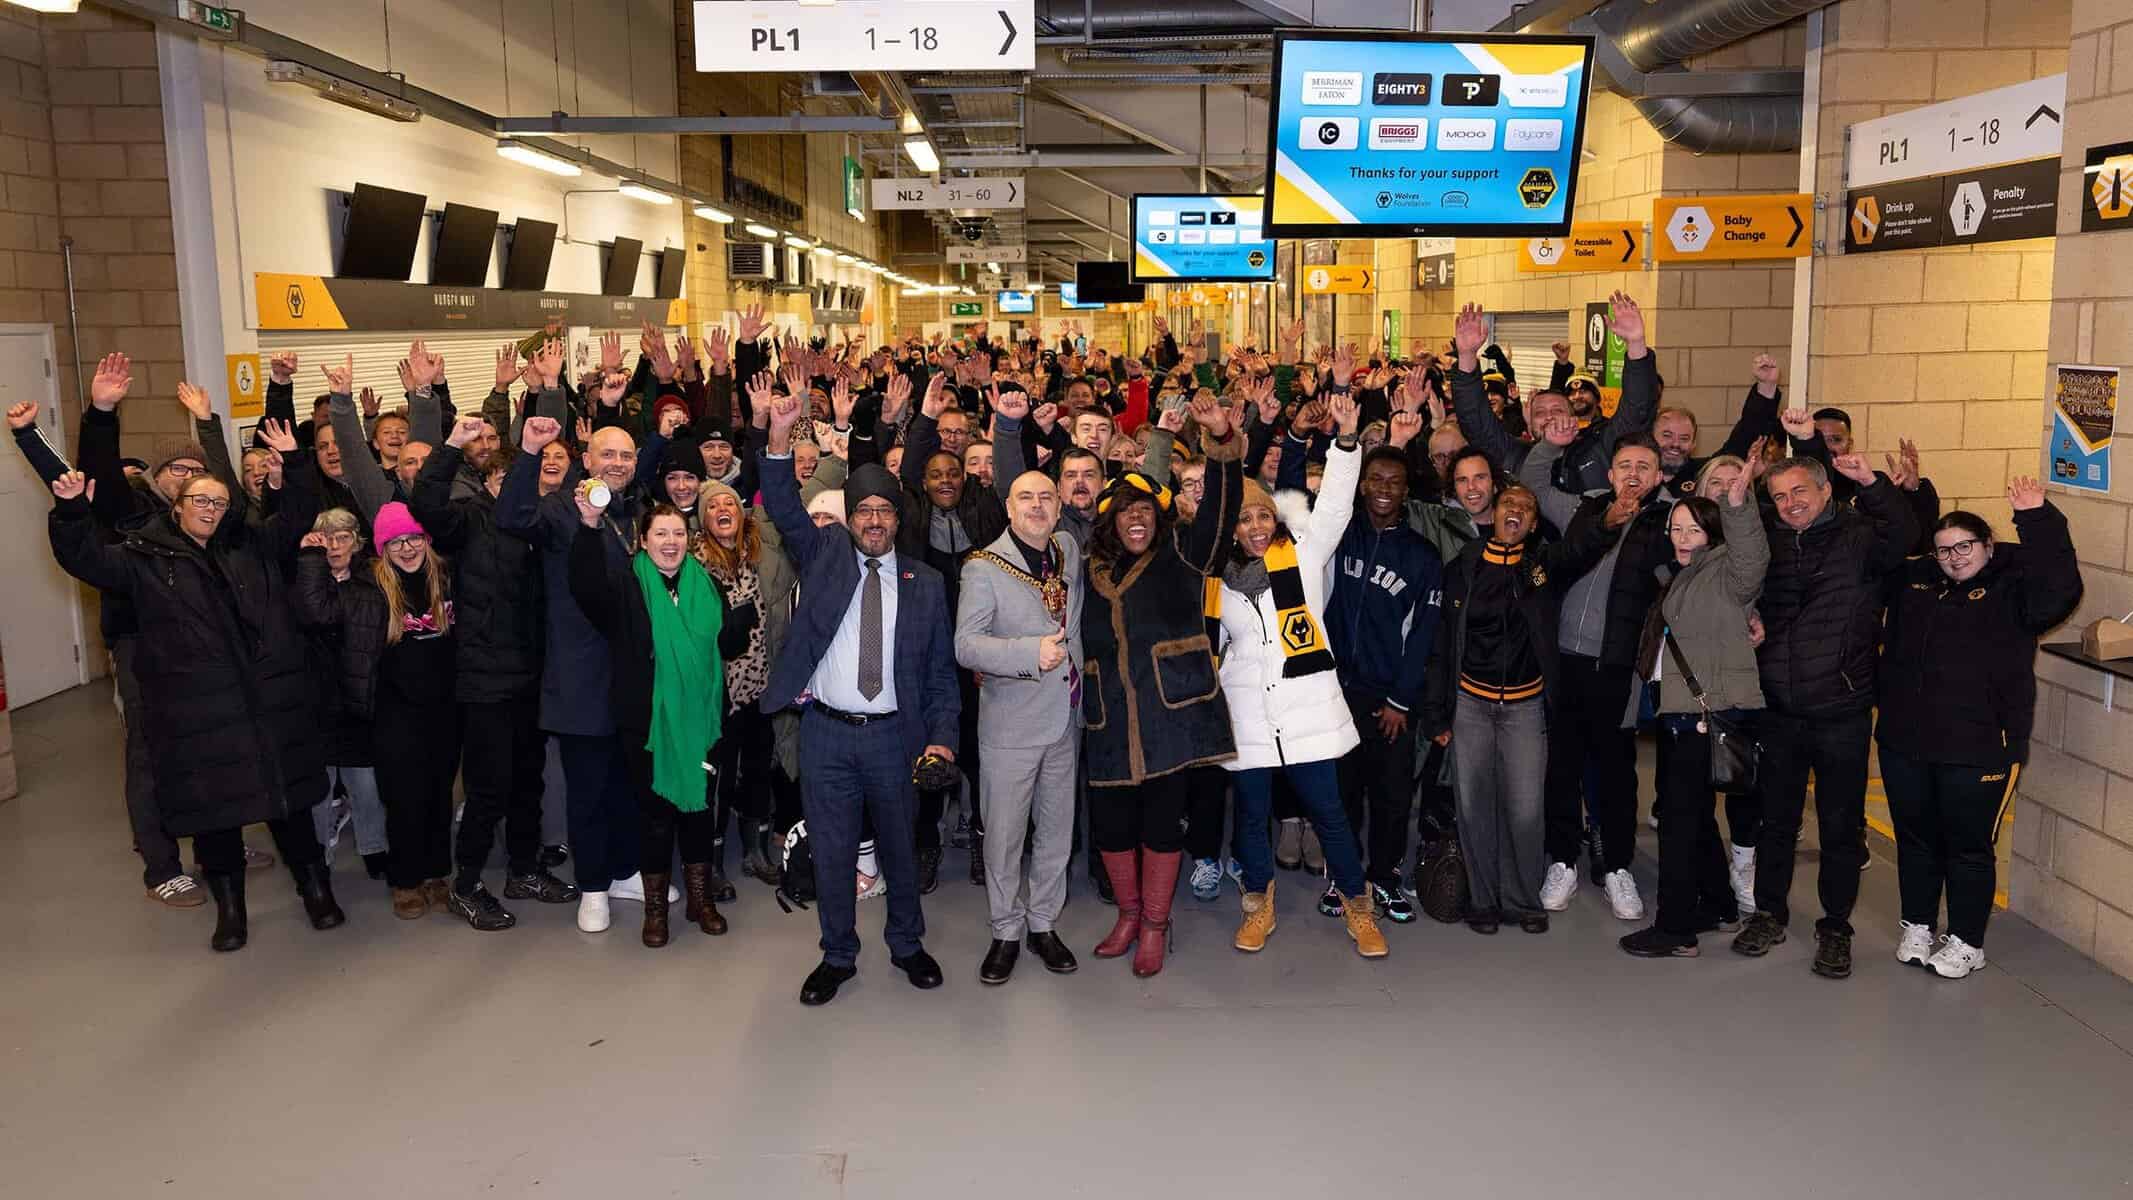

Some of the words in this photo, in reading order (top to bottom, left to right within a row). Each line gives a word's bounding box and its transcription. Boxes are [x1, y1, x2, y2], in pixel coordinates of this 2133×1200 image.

[751, 27, 800, 52] PL1
[1377, 83, 1426, 95] EIGHTY3
[1381, 127, 1416, 136] BRIGGS
[1879, 137, 1909, 166] PL1
[1349, 166, 1395, 179] Thanks
[1398, 166, 1417, 179] for
[1419, 168, 1448, 181] your
[1451, 167, 1500, 181] support
[897, 190, 924, 201] NL2
[1993, 185, 2026, 201] Penalty
[1885, 201, 1903, 214] Drink
[1904, 202, 1914, 214] up
[1723, 215, 1752, 227] Baby
[1573, 236, 1613, 247] Accessible
[1723, 230, 1766, 243] Change
[1573, 249, 1596, 258] Toilet
